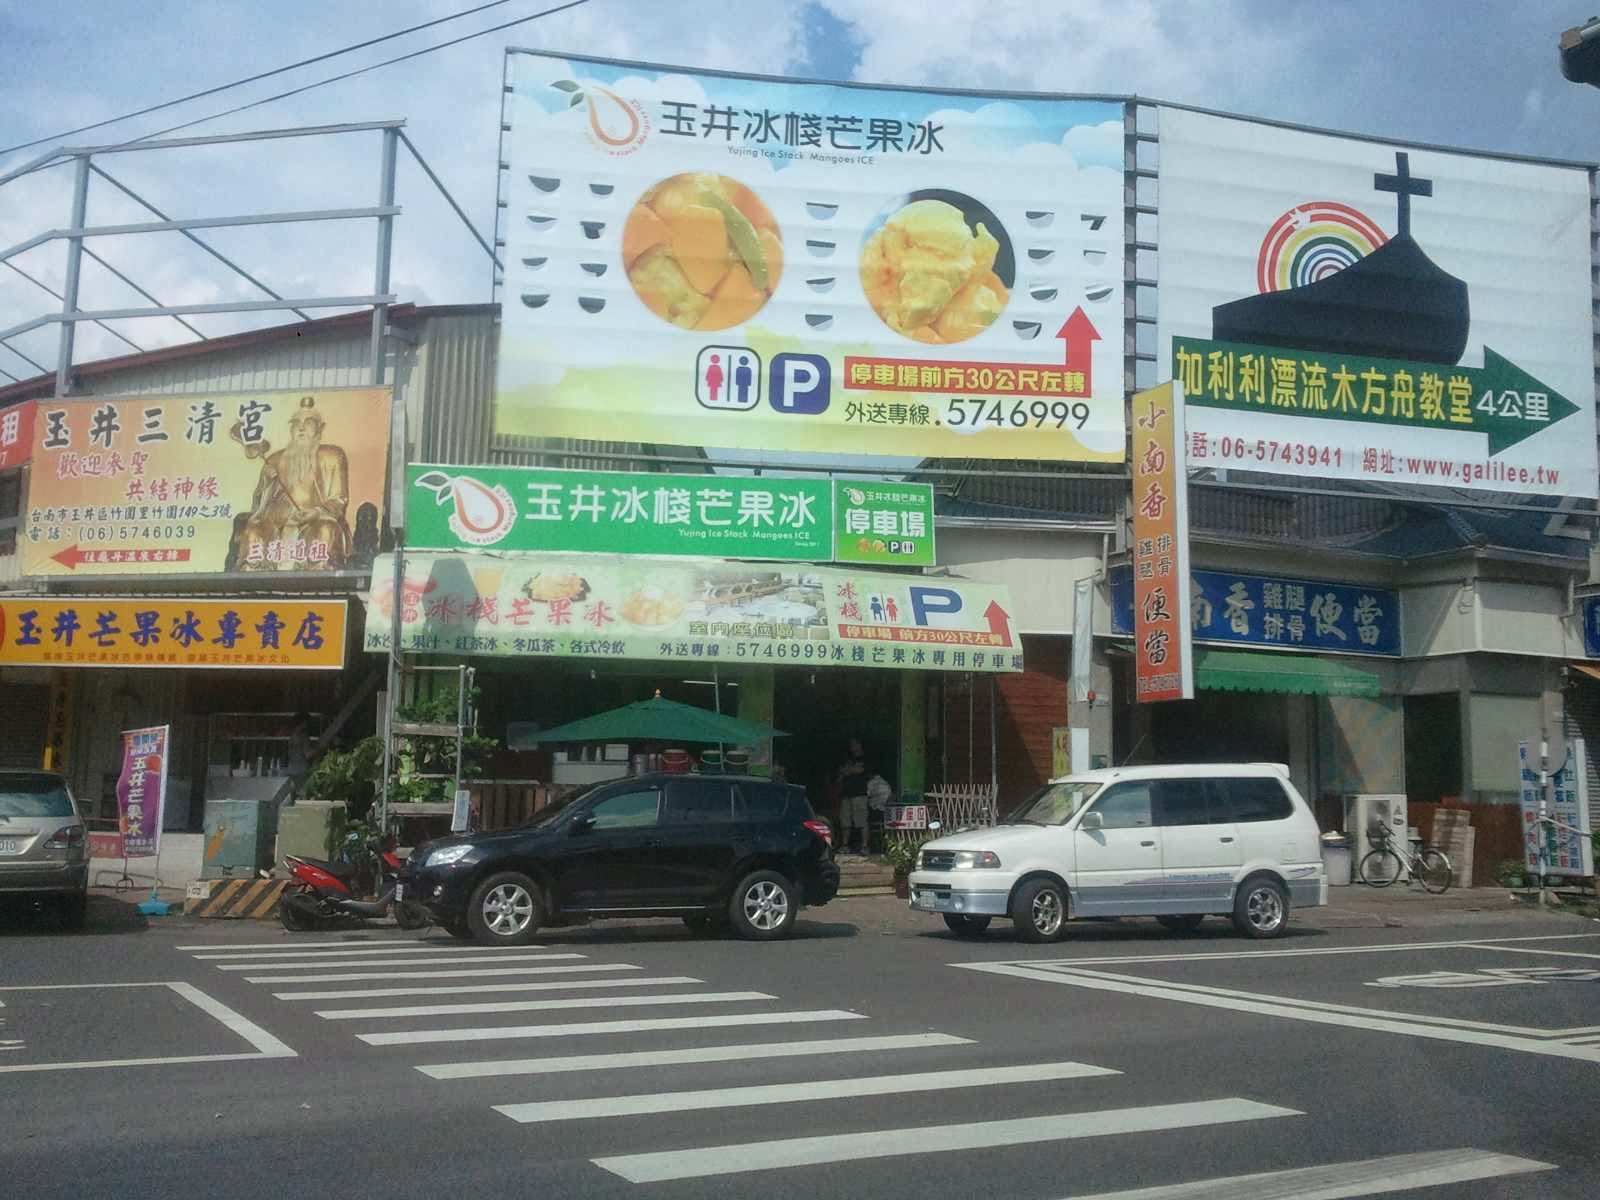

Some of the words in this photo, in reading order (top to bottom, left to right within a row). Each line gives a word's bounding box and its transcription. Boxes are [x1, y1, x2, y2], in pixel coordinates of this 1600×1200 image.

[659, 99, 944, 155] 玉井冰棧芒果冰
[761, 149, 776, 158] Ice
[810, 153, 854, 164] Mangoes
[857, 156, 874, 165] ICE
[850, 363, 1086, 394] 停車場前方30公尺左轉
[1176, 346, 1474, 425] 加利利漂流木方舟教堂
[1477, 388, 1550, 423] 4公里
[43, 400, 272, 450] 玉井三清宮
[1138, 400, 1168, 521] 小南香
[1185, 431, 1343, 468] 話:06-5743941
[525, 482, 816, 528] 玉井冰棧芒果冰
[845, 508, 926, 538] 停車場
[909, 586, 963, 626] P
[1143, 587, 1172, 666] 便當
[1310, 592, 1384, 646] 便當
[15, 609, 325, 650] 玉井芒果冰專賣店
